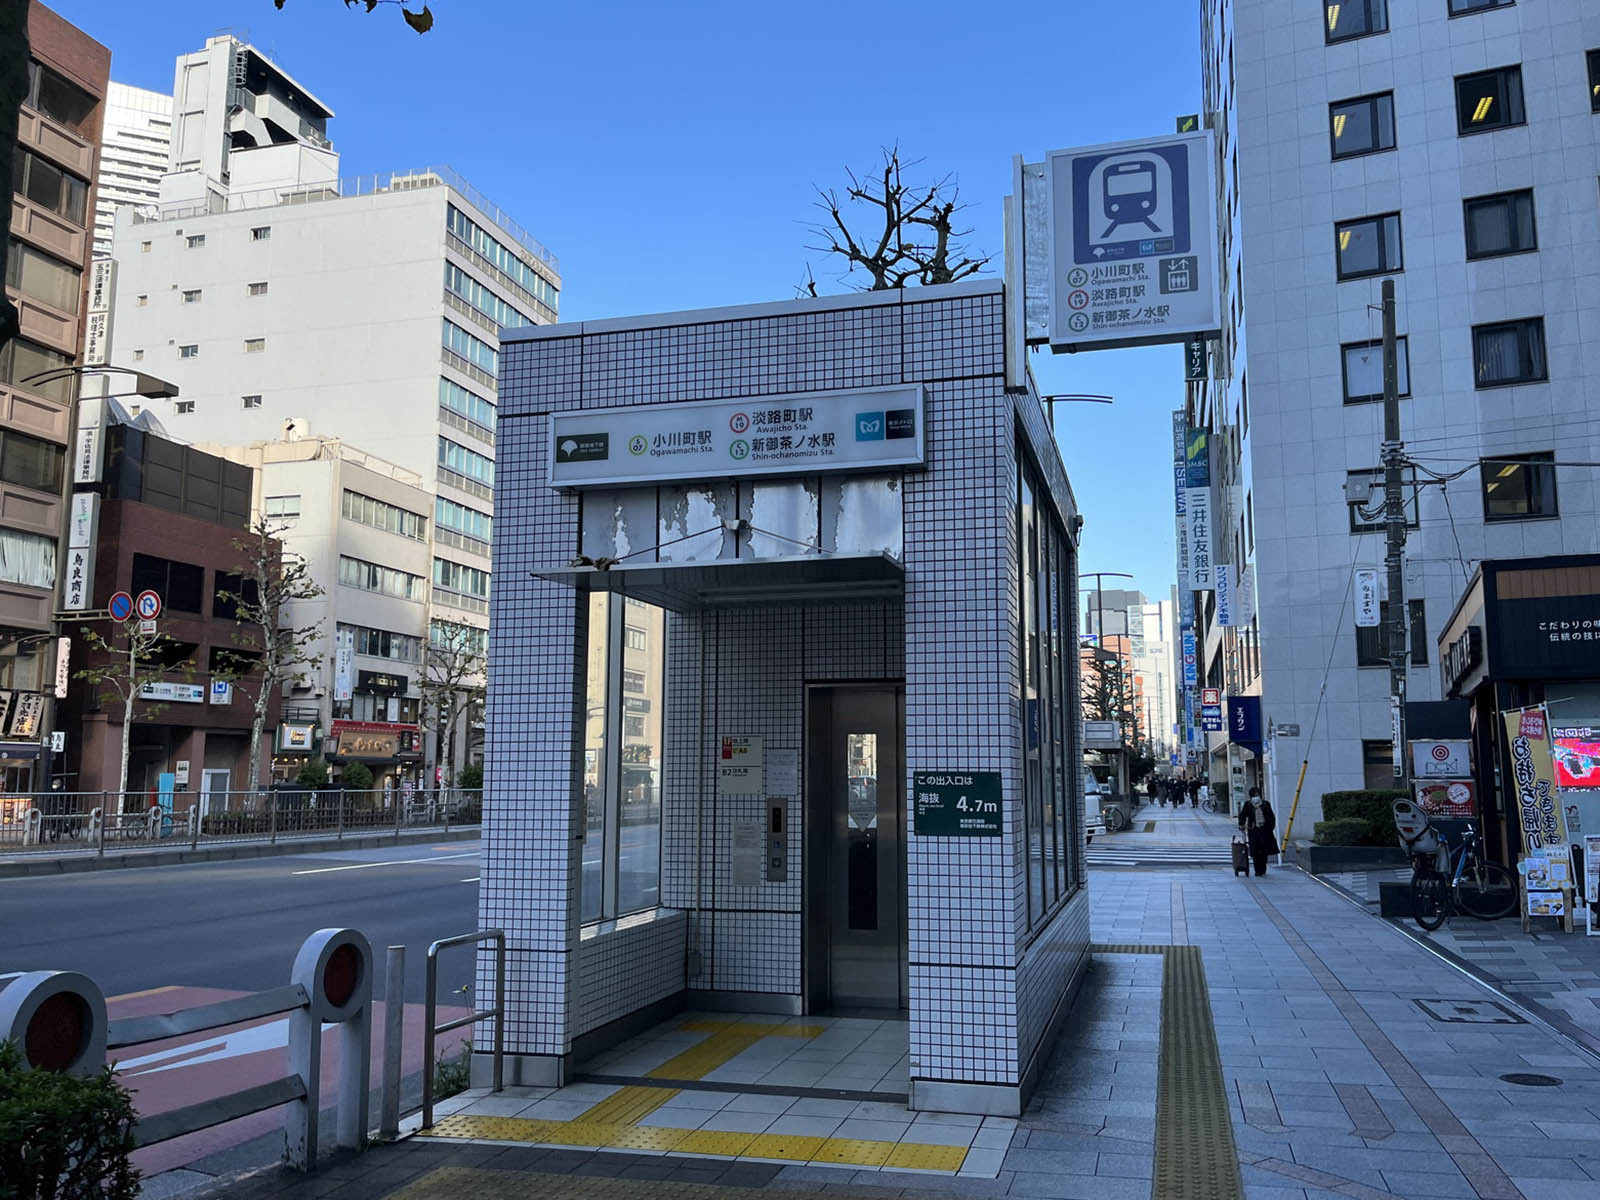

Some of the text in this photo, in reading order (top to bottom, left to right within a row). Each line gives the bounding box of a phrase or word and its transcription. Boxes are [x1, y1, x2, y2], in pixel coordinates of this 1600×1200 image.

[1091, 262, 1145, 279] 小川町駅
[1091, 276, 1135, 286] Ogawamachi
[1091, 285, 1146, 301] 淡路町駅
[1091, 299, 1125, 308] Awajicho
[1092, 305, 1170, 323] 新御茶ノ水駅
[1092, 320, 1152, 329] Shin-ochanomizu
[1192, 342, 1201, 376] キャリア
[752, 407, 814, 425] 淡路町駅
[756, 422, 808, 435] Awajicho Sta.
[652, 430, 712, 448] 小川町駅
[752, 433, 836, 452] 新御茶ノ水駅
[650, 445, 714, 457] Ogawamachi Sta.
[752, 449, 834, 461] Shin-ochanomizu Sta.
[1192, 493, 1210, 583] 三井住友銀行
[1184, 634, 1196, 681] KINGRUN
[1236, 706, 1245, 731] エフワン
[918, 776, 974, 786] この出入口は
[918, 792, 940, 804] 海抜
[1512, 736, 1543, 852] お持ち帰り
